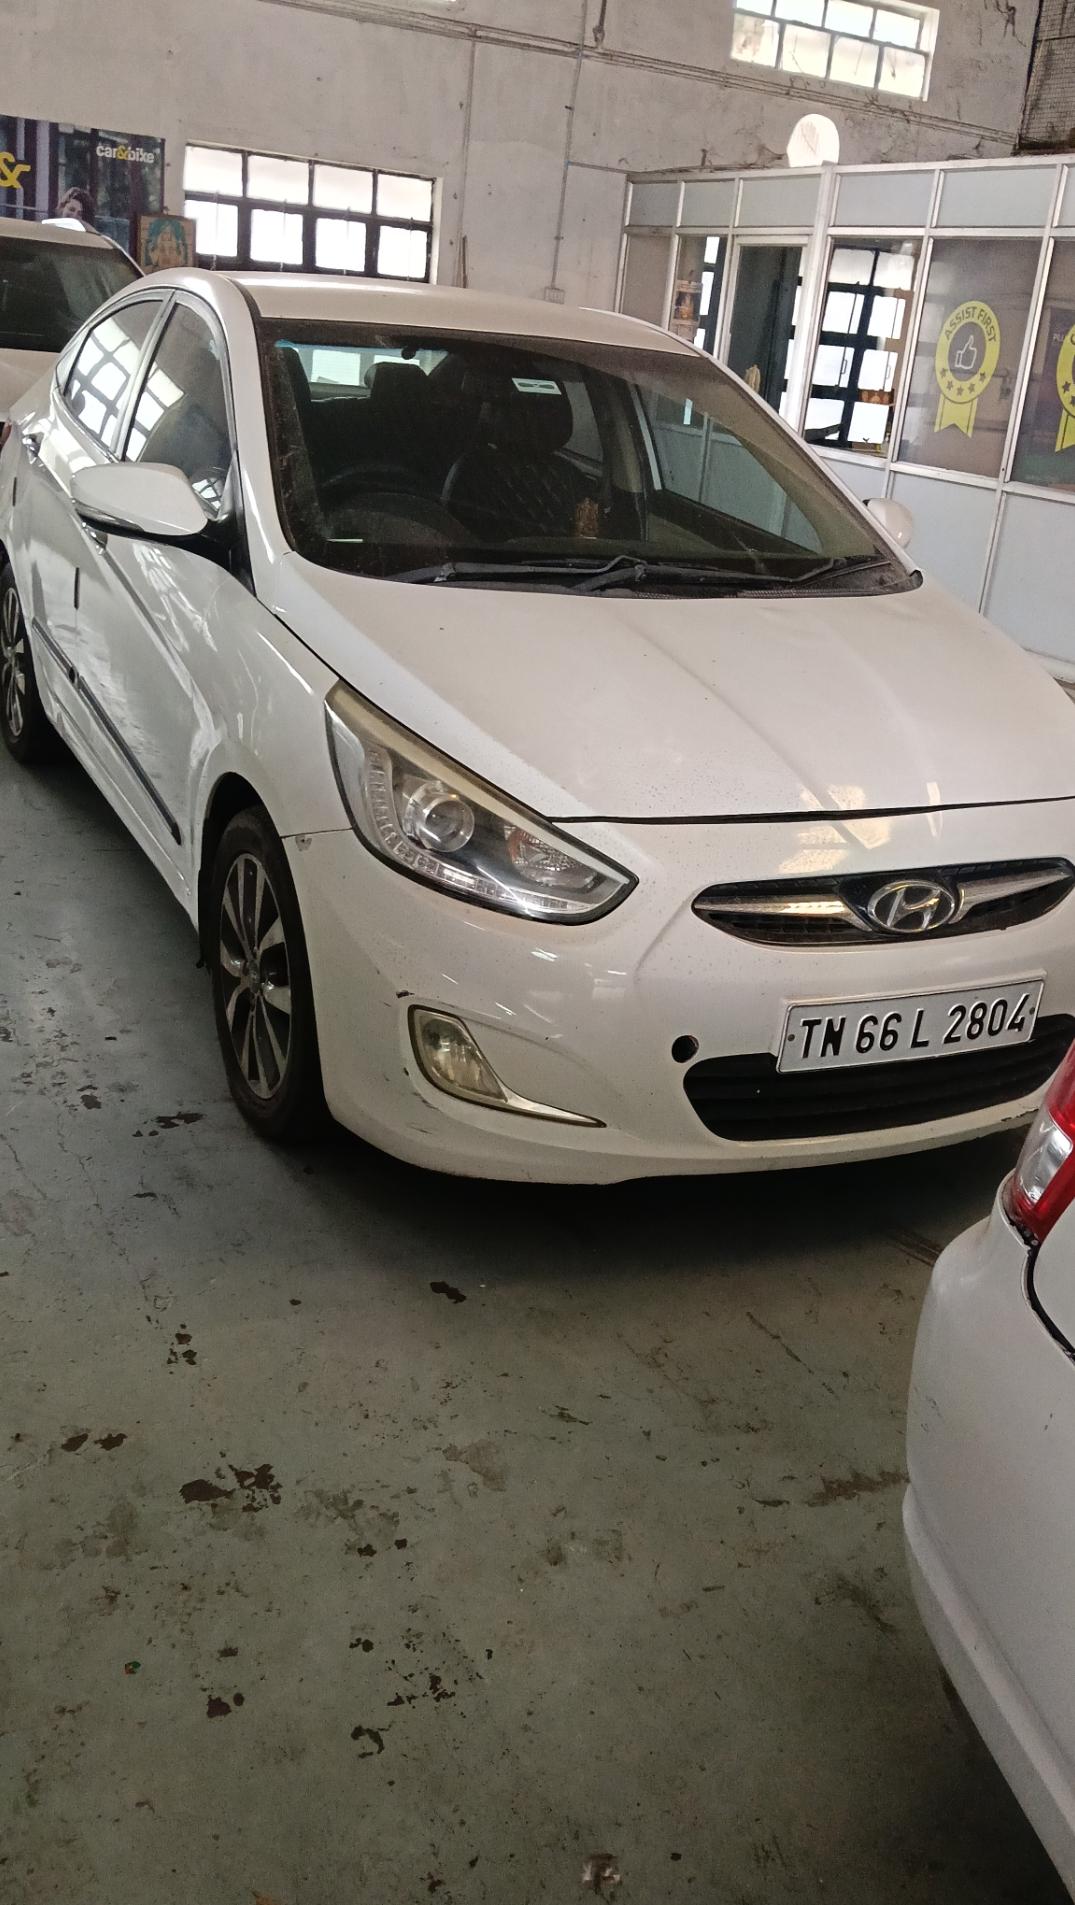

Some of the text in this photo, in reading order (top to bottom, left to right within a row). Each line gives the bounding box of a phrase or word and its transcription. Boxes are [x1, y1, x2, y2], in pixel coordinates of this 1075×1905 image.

[96, 144, 155, 163] car&bike
[944, 306, 997, 342] ASSIST FIRST
[801, 993, 1030, 1058] TN 66 L 2804
